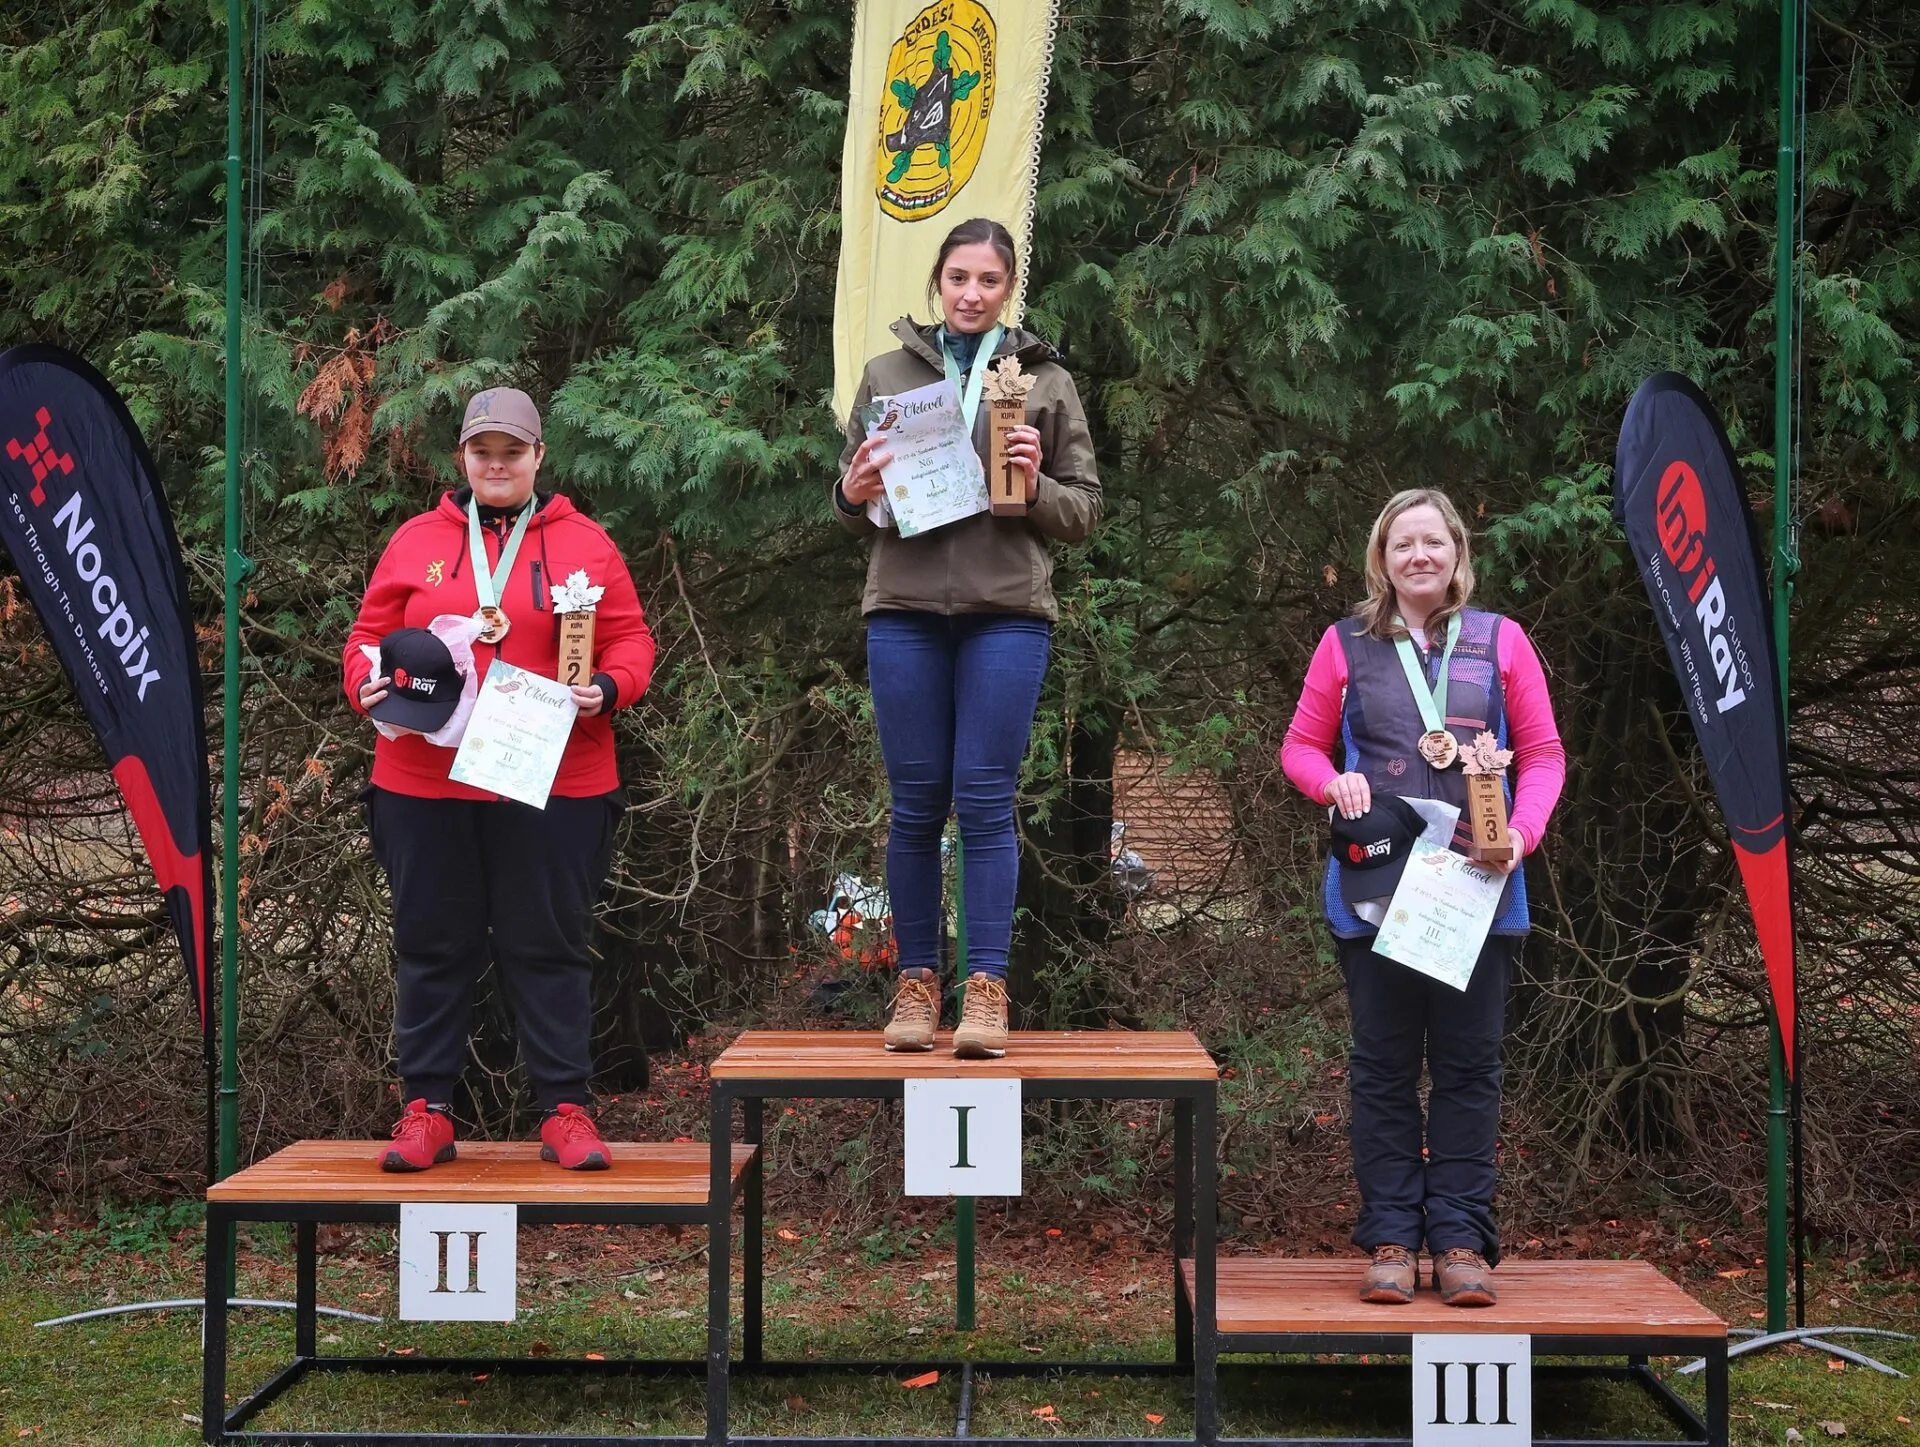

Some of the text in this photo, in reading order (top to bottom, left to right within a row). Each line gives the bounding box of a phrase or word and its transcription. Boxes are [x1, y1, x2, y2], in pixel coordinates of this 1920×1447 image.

[904, 395, 944, 418] Oklevél
[1002, 461, 1012, 496] 1
[8, 493, 109, 695] See Through The Darkness
[53, 491, 161, 702] Nocpix
[1453, 645, 1486, 655] STELLANI
[1650, 553, 1663, 588] Ultra
[1680, 638, 1694, 673] Ultra
[1690, 672, 1708, 724] Precise
[1727, 616, 1755, 690] Outdoor
[524, 686, 566, 709] Oklevél
[567, 662, 580, 686] 2
[1486, 820, 1497, 842] 3
[1451, 860, 1491, 884] Oklevél
[949, 1106, 977, 1168] I
[429, 1230, 486, 1293] II
[1427, 1362, 1517, 1425] III
